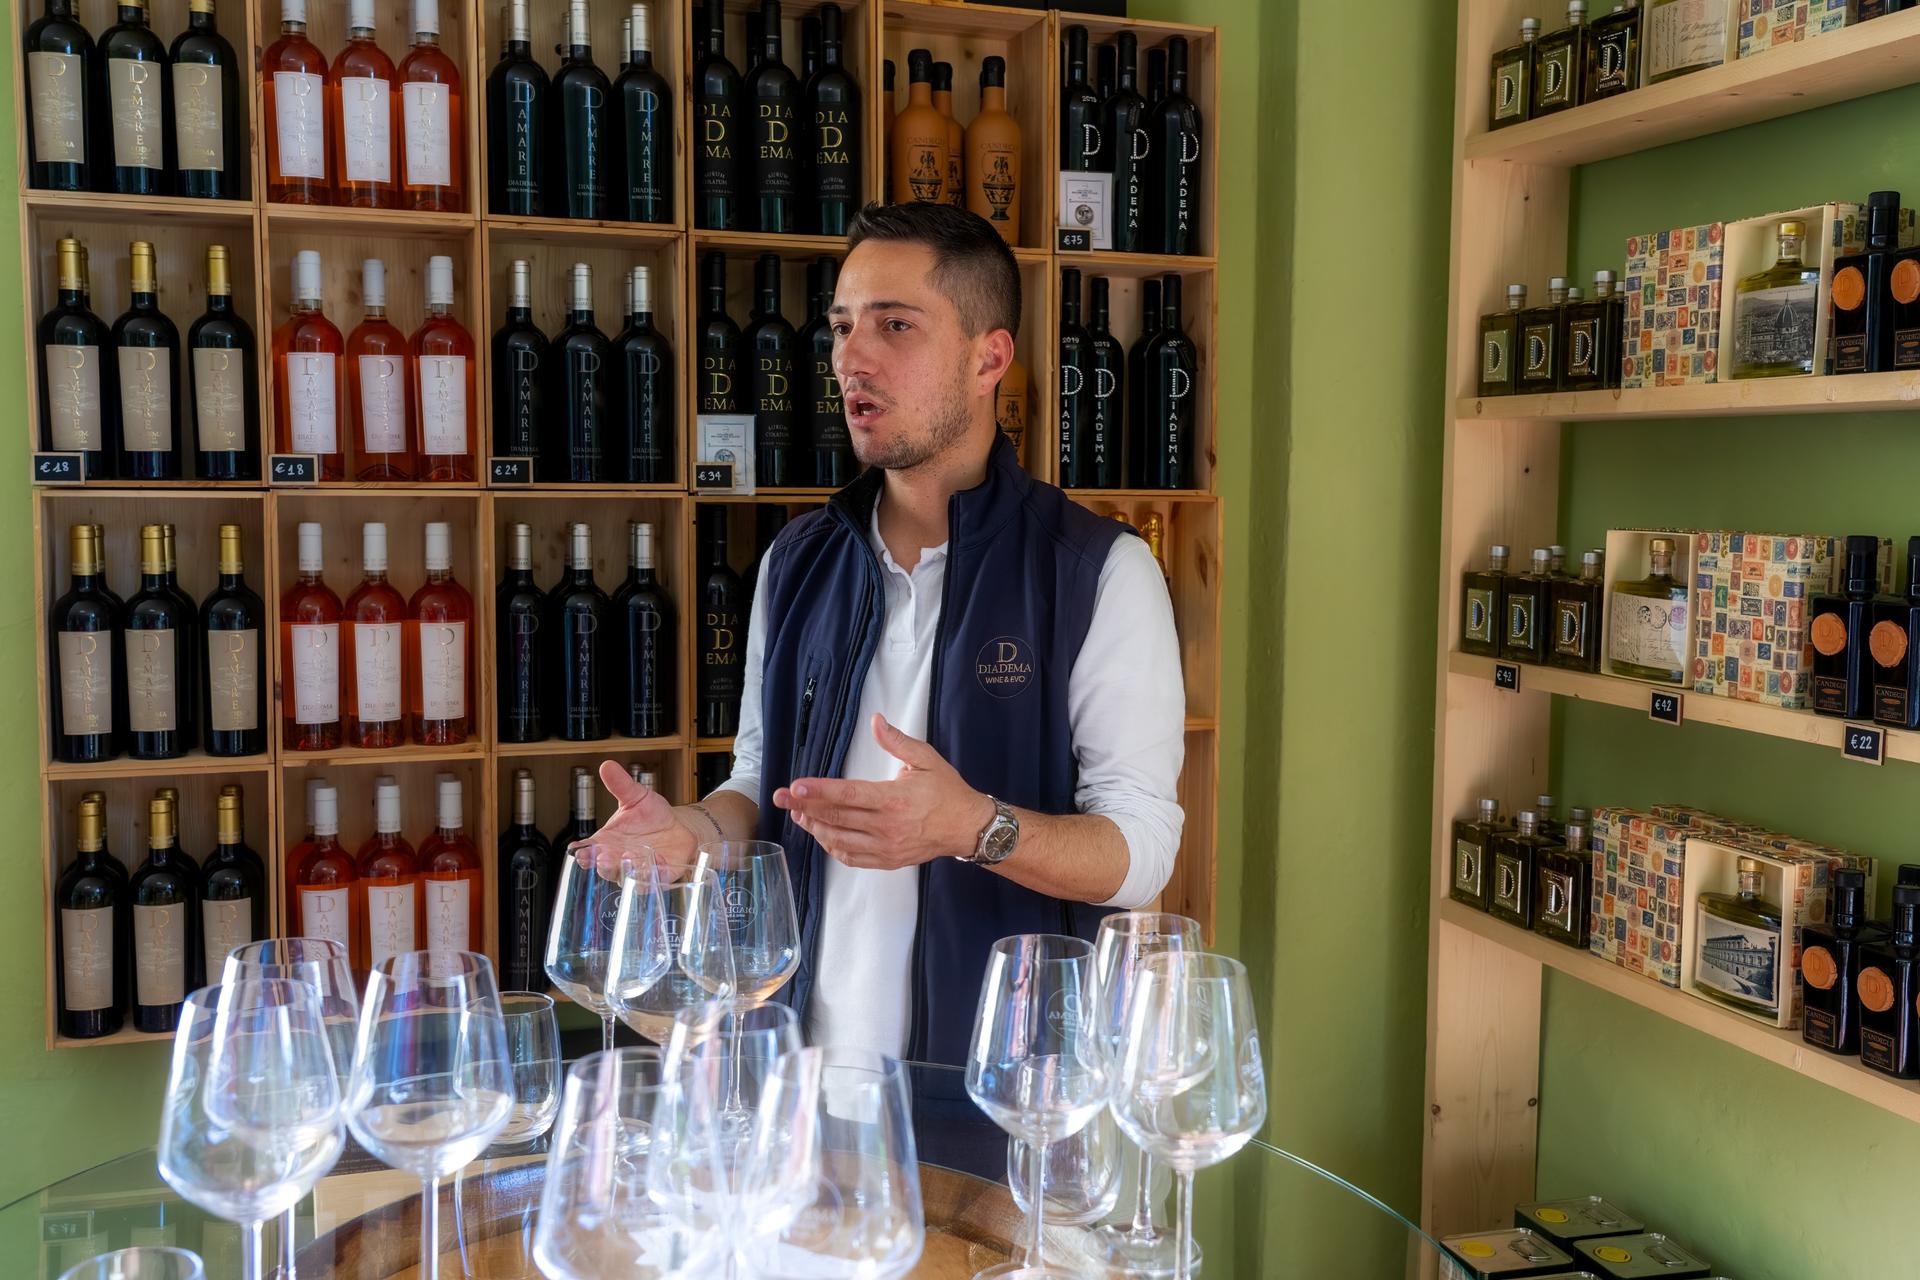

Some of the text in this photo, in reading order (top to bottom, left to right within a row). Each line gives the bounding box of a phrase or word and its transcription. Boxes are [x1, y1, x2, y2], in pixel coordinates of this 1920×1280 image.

[760, 105, 792, 118] DIA
[816, 111, 848, 123] DIA
[761, 146, 793, 159] EMA
[817, 151, 849, 163] EMA
[1063, 235, 1082, 245] €75
[705, 357, 736, 370] DIA
[760, 358, 792, 371] DIA
[705, 399, 736, 410] EMA
[760, 399, 792, 411] EMA
[707, 613, 738, 625] DIA
[996, 642, 1017, 663] D
[706, 654, 737, 664] EMA
[978, 663, 1032, 674] DIADEMA
[1655, 699, 1672, 712] €42
[1851, 734, 1872, 750] €22
